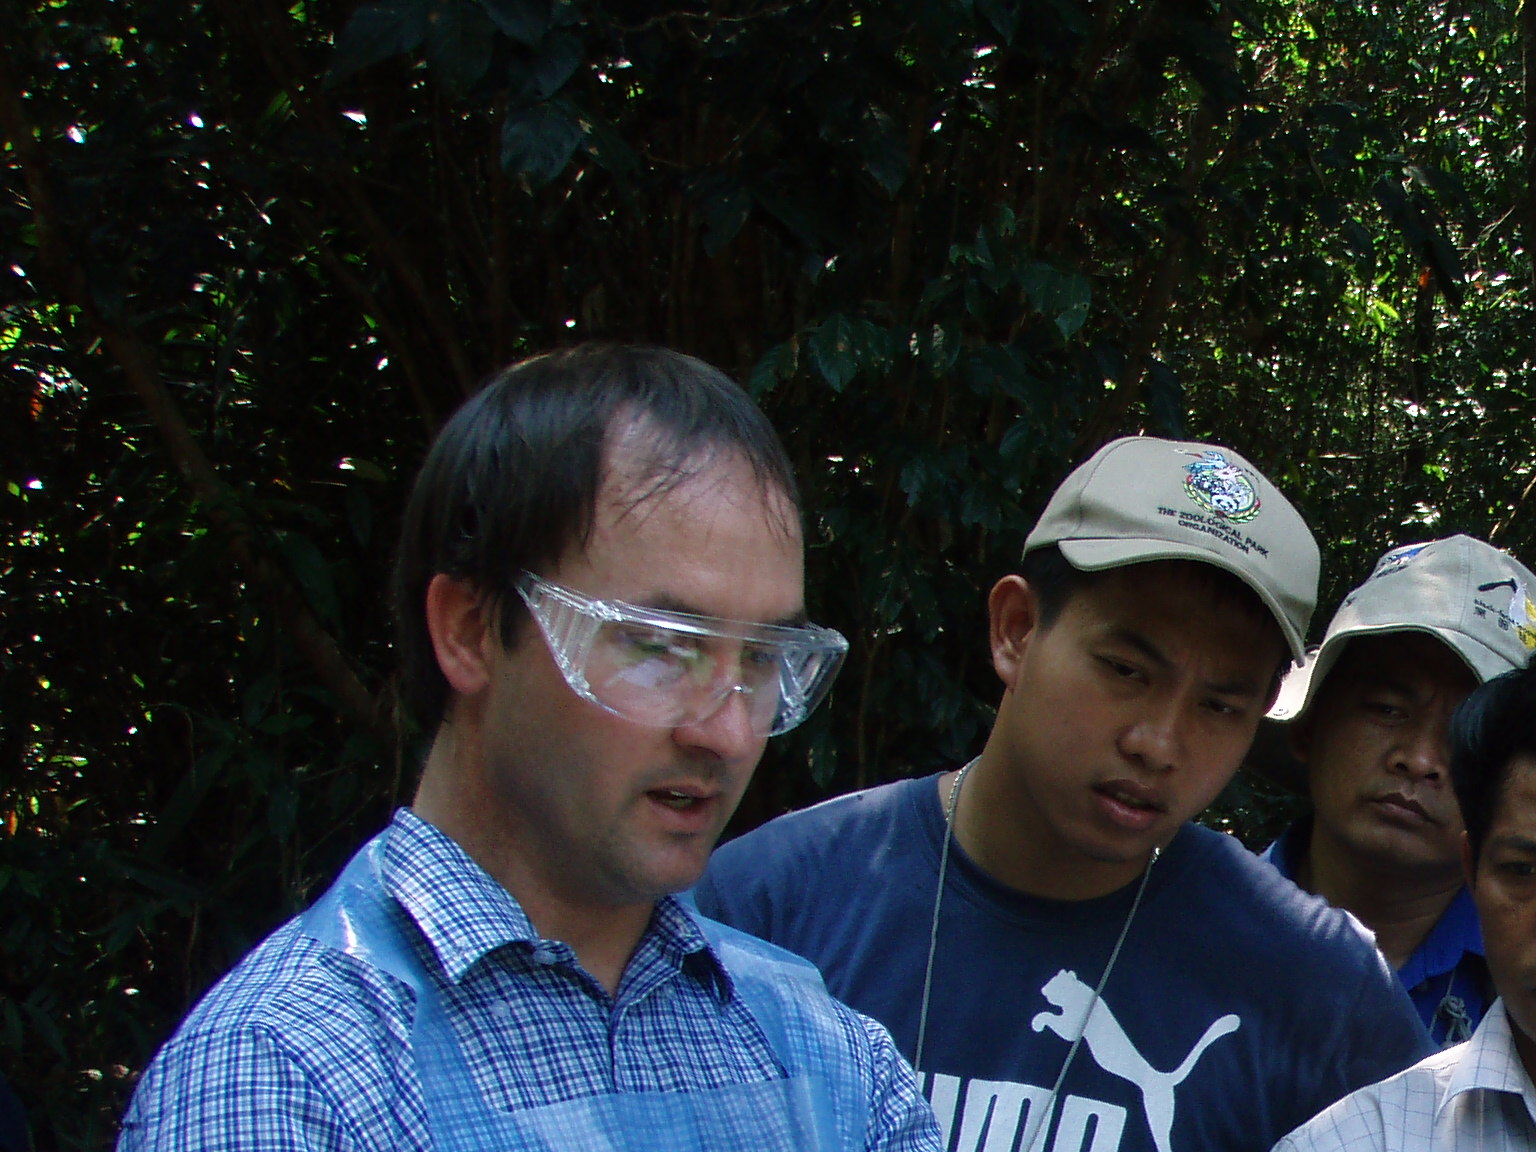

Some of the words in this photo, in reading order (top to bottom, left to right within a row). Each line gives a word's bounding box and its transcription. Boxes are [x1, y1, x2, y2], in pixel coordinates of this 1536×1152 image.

[1158, 507, 1177, 517] THE
[1180, 511, 1242, 540] ZOOLOGICAL
[1245, 536, 1269, 559] PARK
[1178, 520, 1249, 554] ORGANIZATION
